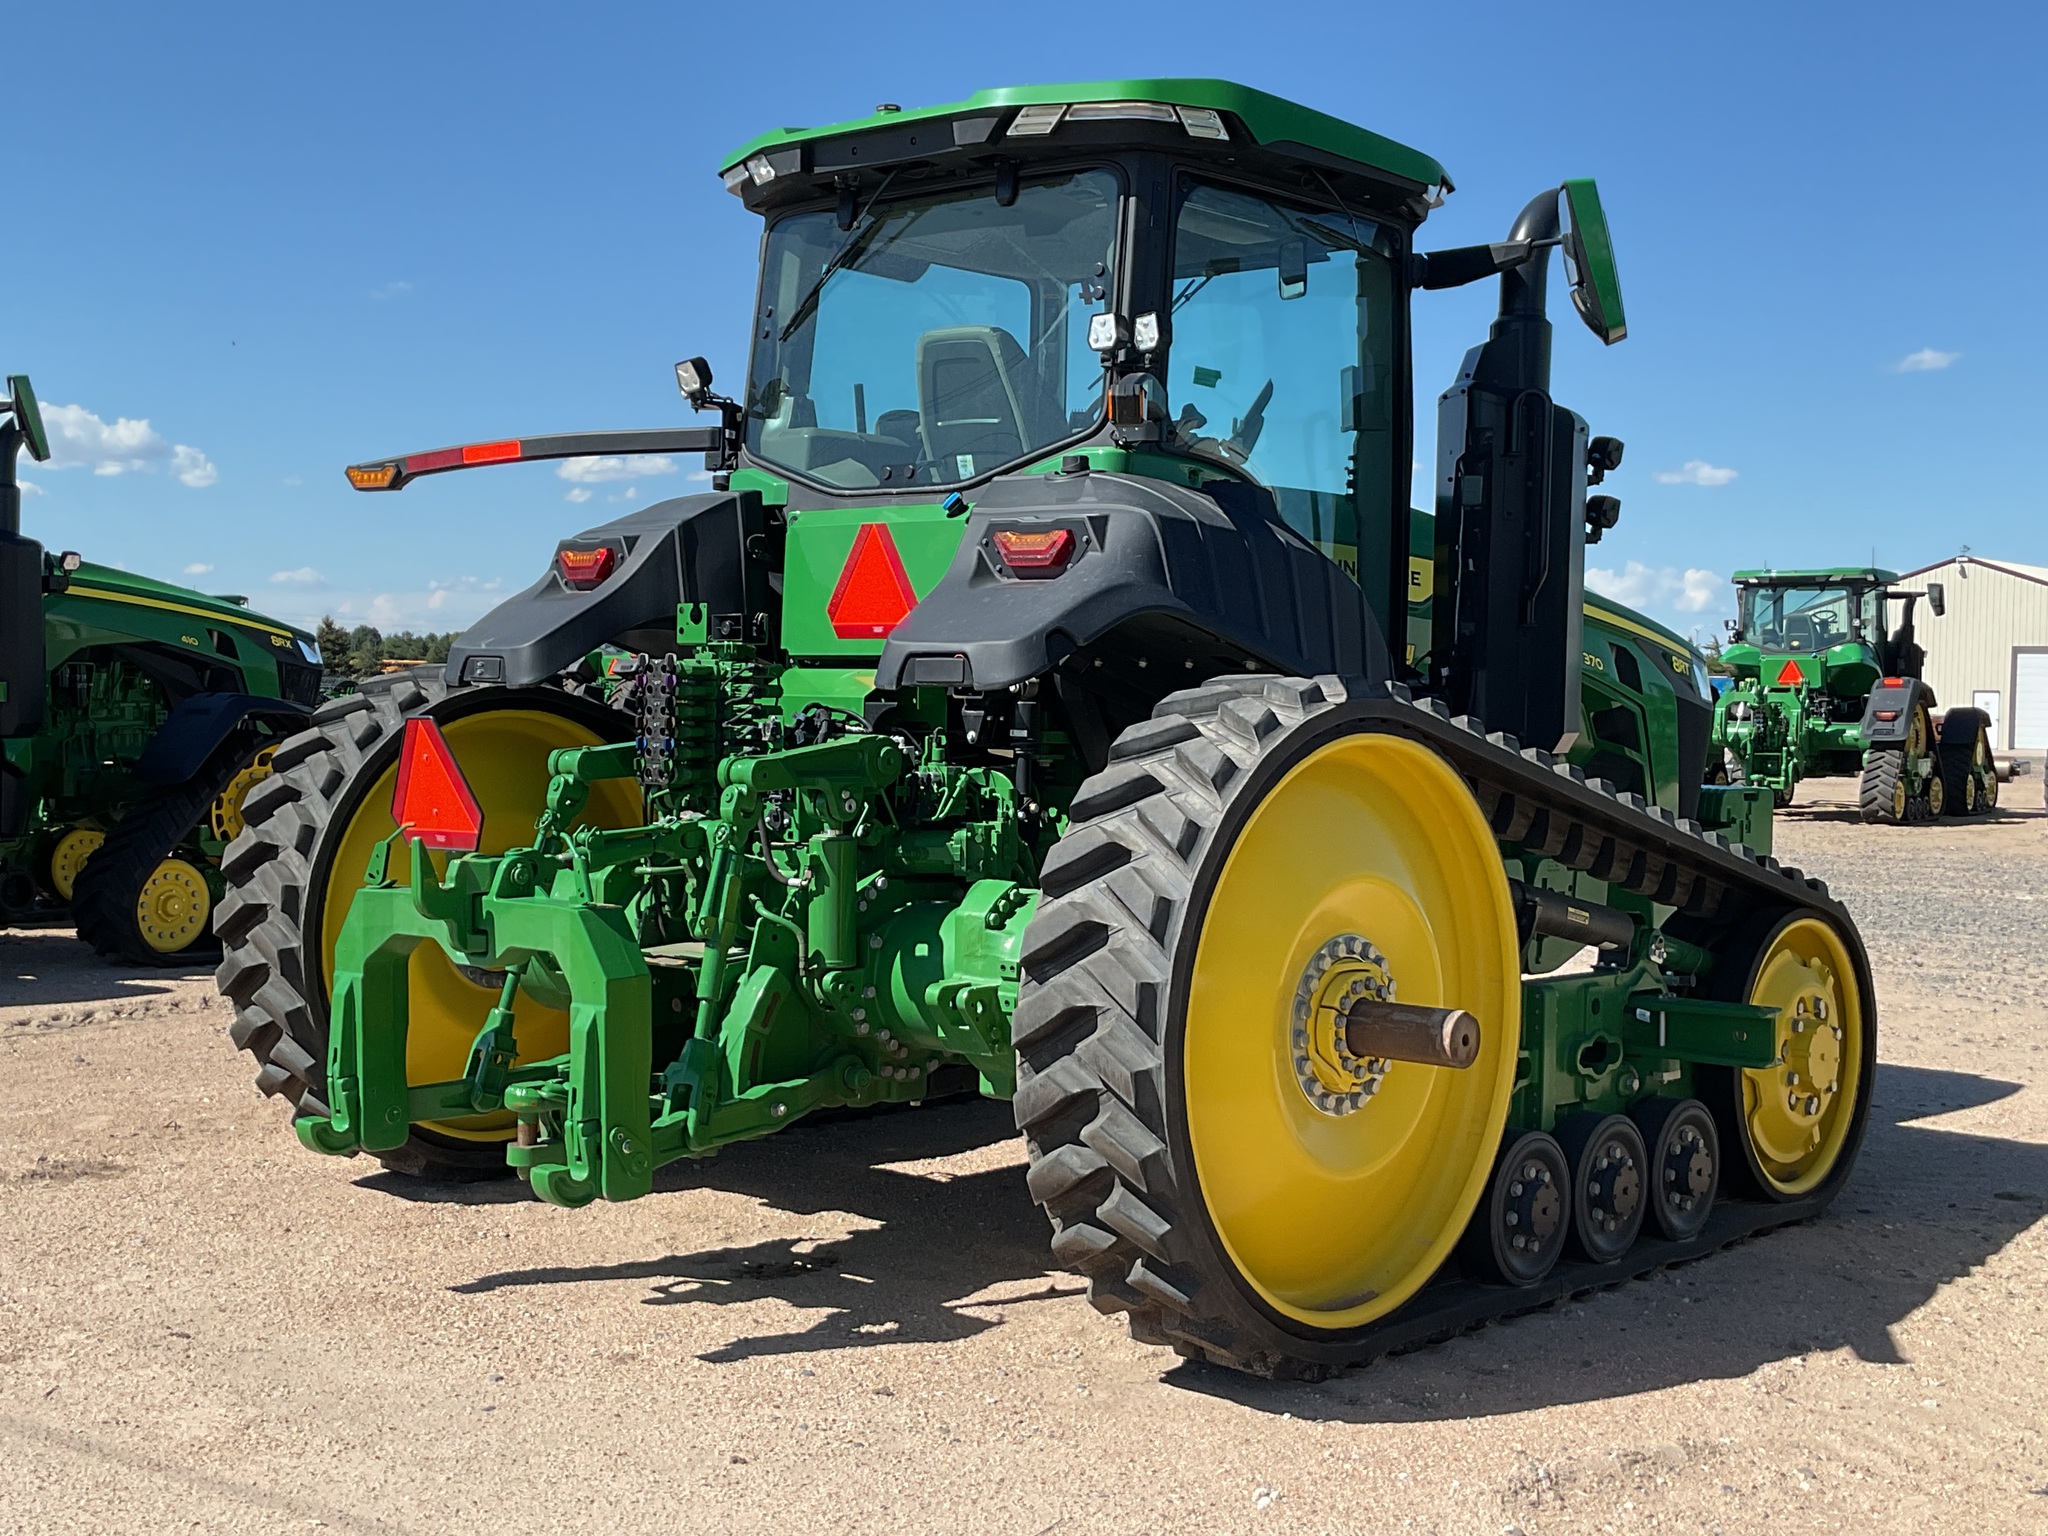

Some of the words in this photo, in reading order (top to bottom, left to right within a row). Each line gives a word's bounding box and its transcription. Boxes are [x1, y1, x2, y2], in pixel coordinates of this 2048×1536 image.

[180, 635, 199, 646] 410
[270, 635, 293, 649] 8RX
[1582, 652, 1604, 670] 370
[1671, 655, 1690, 676] 8RT
